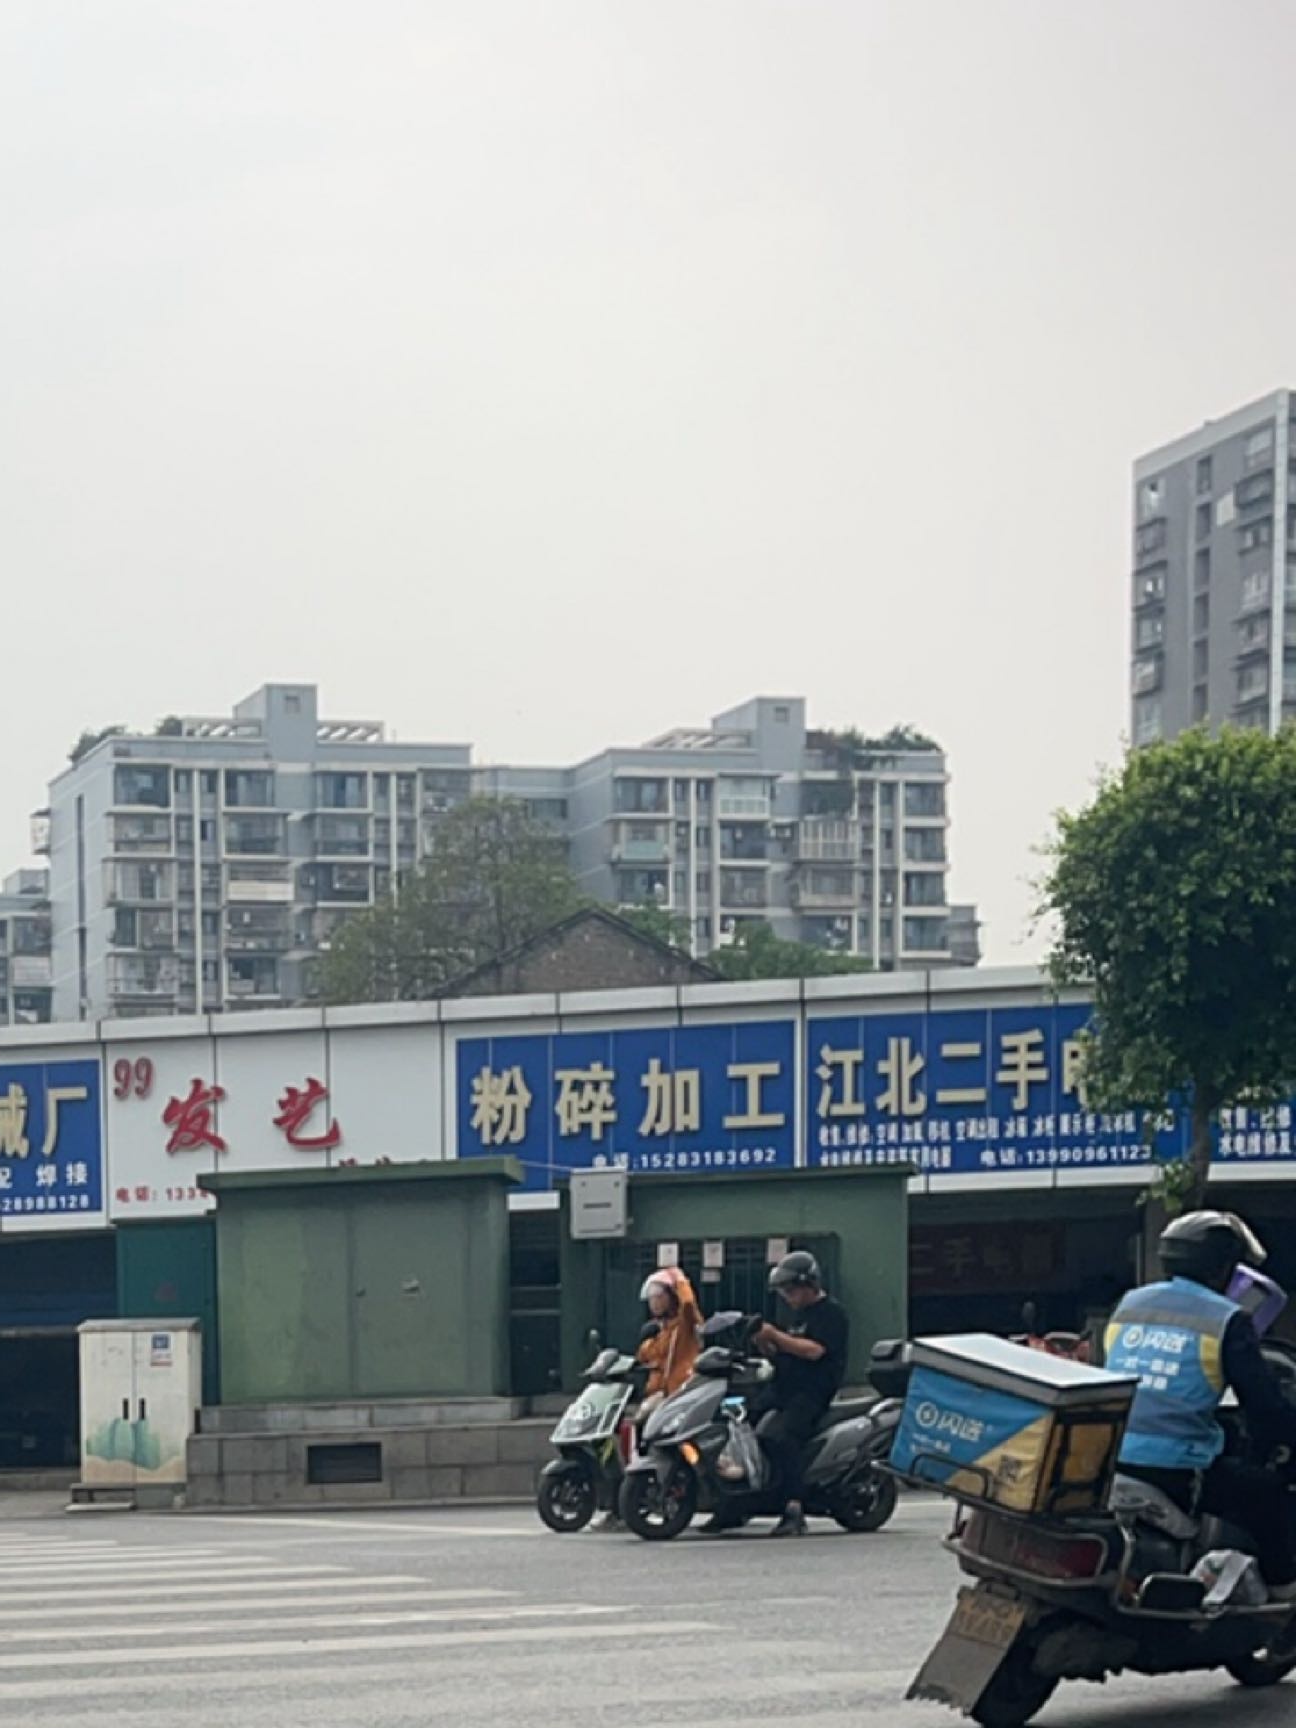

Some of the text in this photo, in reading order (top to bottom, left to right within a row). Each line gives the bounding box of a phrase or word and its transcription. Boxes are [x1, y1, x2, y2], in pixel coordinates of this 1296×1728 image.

[113, 1057, 153, 1100] 99
[163, 1077, 342, 1155] 发艺
[470, 1058, 785, 1145] 粉碎加工
